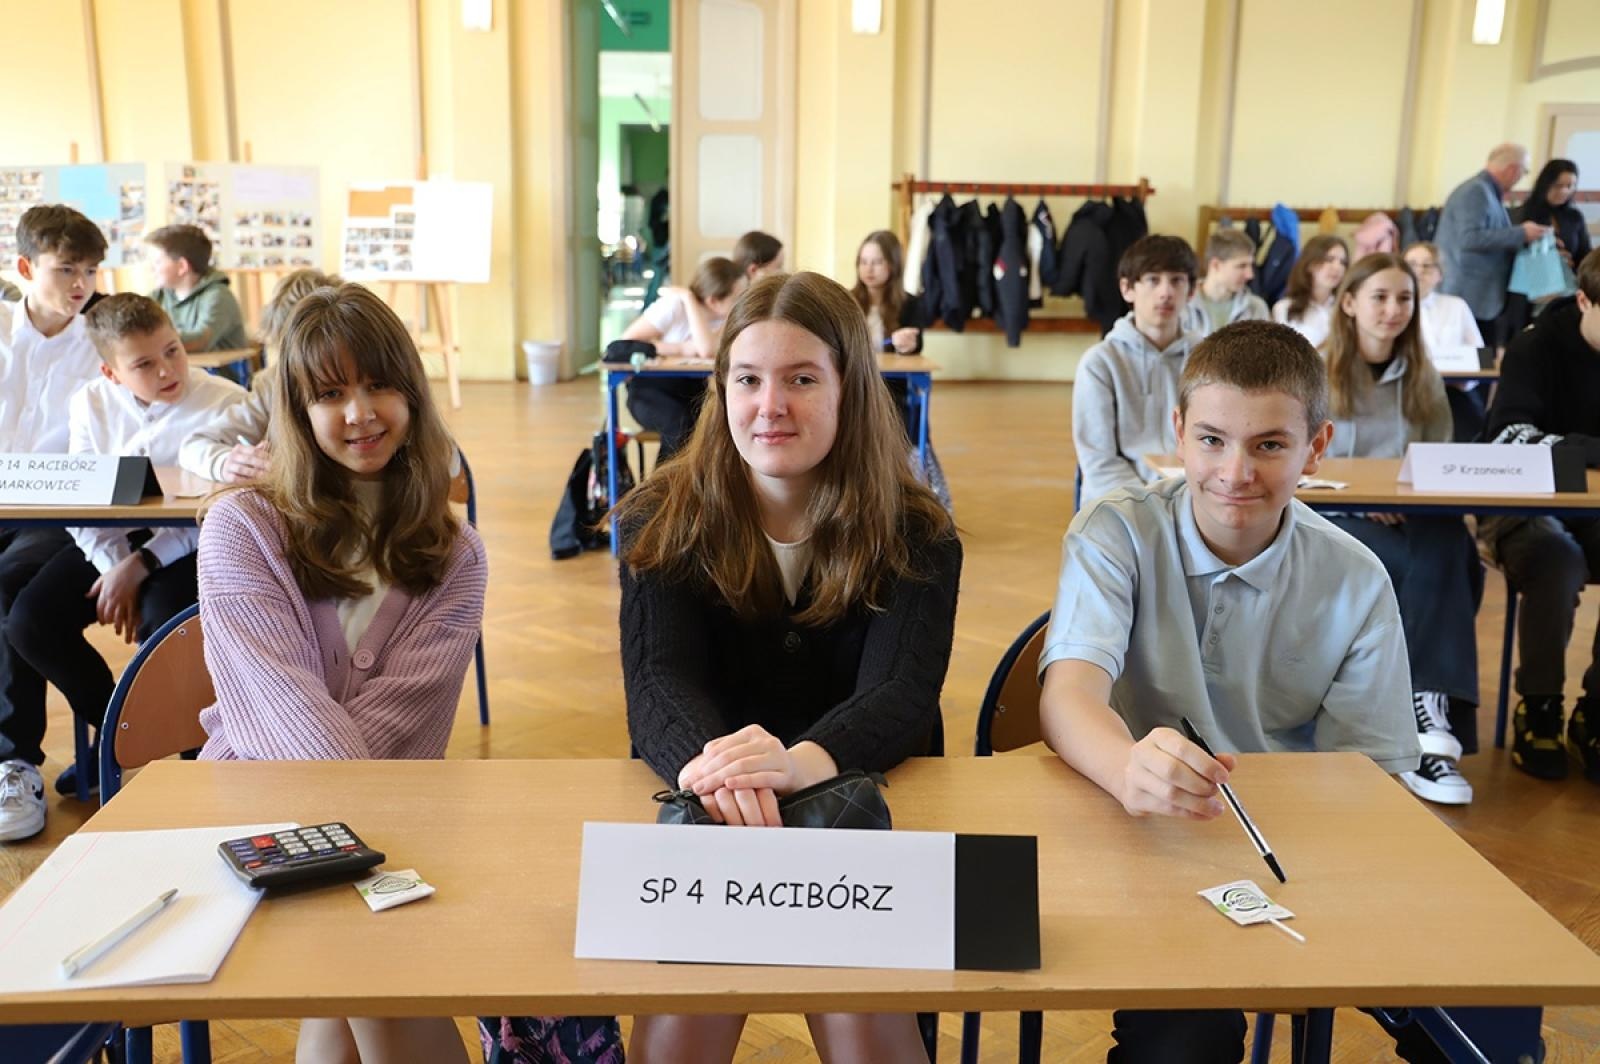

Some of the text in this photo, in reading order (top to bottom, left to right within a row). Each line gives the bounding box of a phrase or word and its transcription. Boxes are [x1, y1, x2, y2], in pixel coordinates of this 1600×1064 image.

[8, 459, 20, 470] 14
[28, 457, 97, 471] RACIBÓRZ
[1442, 464, 1523, 476] SP Krzanowice
[640, 874, 894, 912] SP 4 RACIBÓRZ
